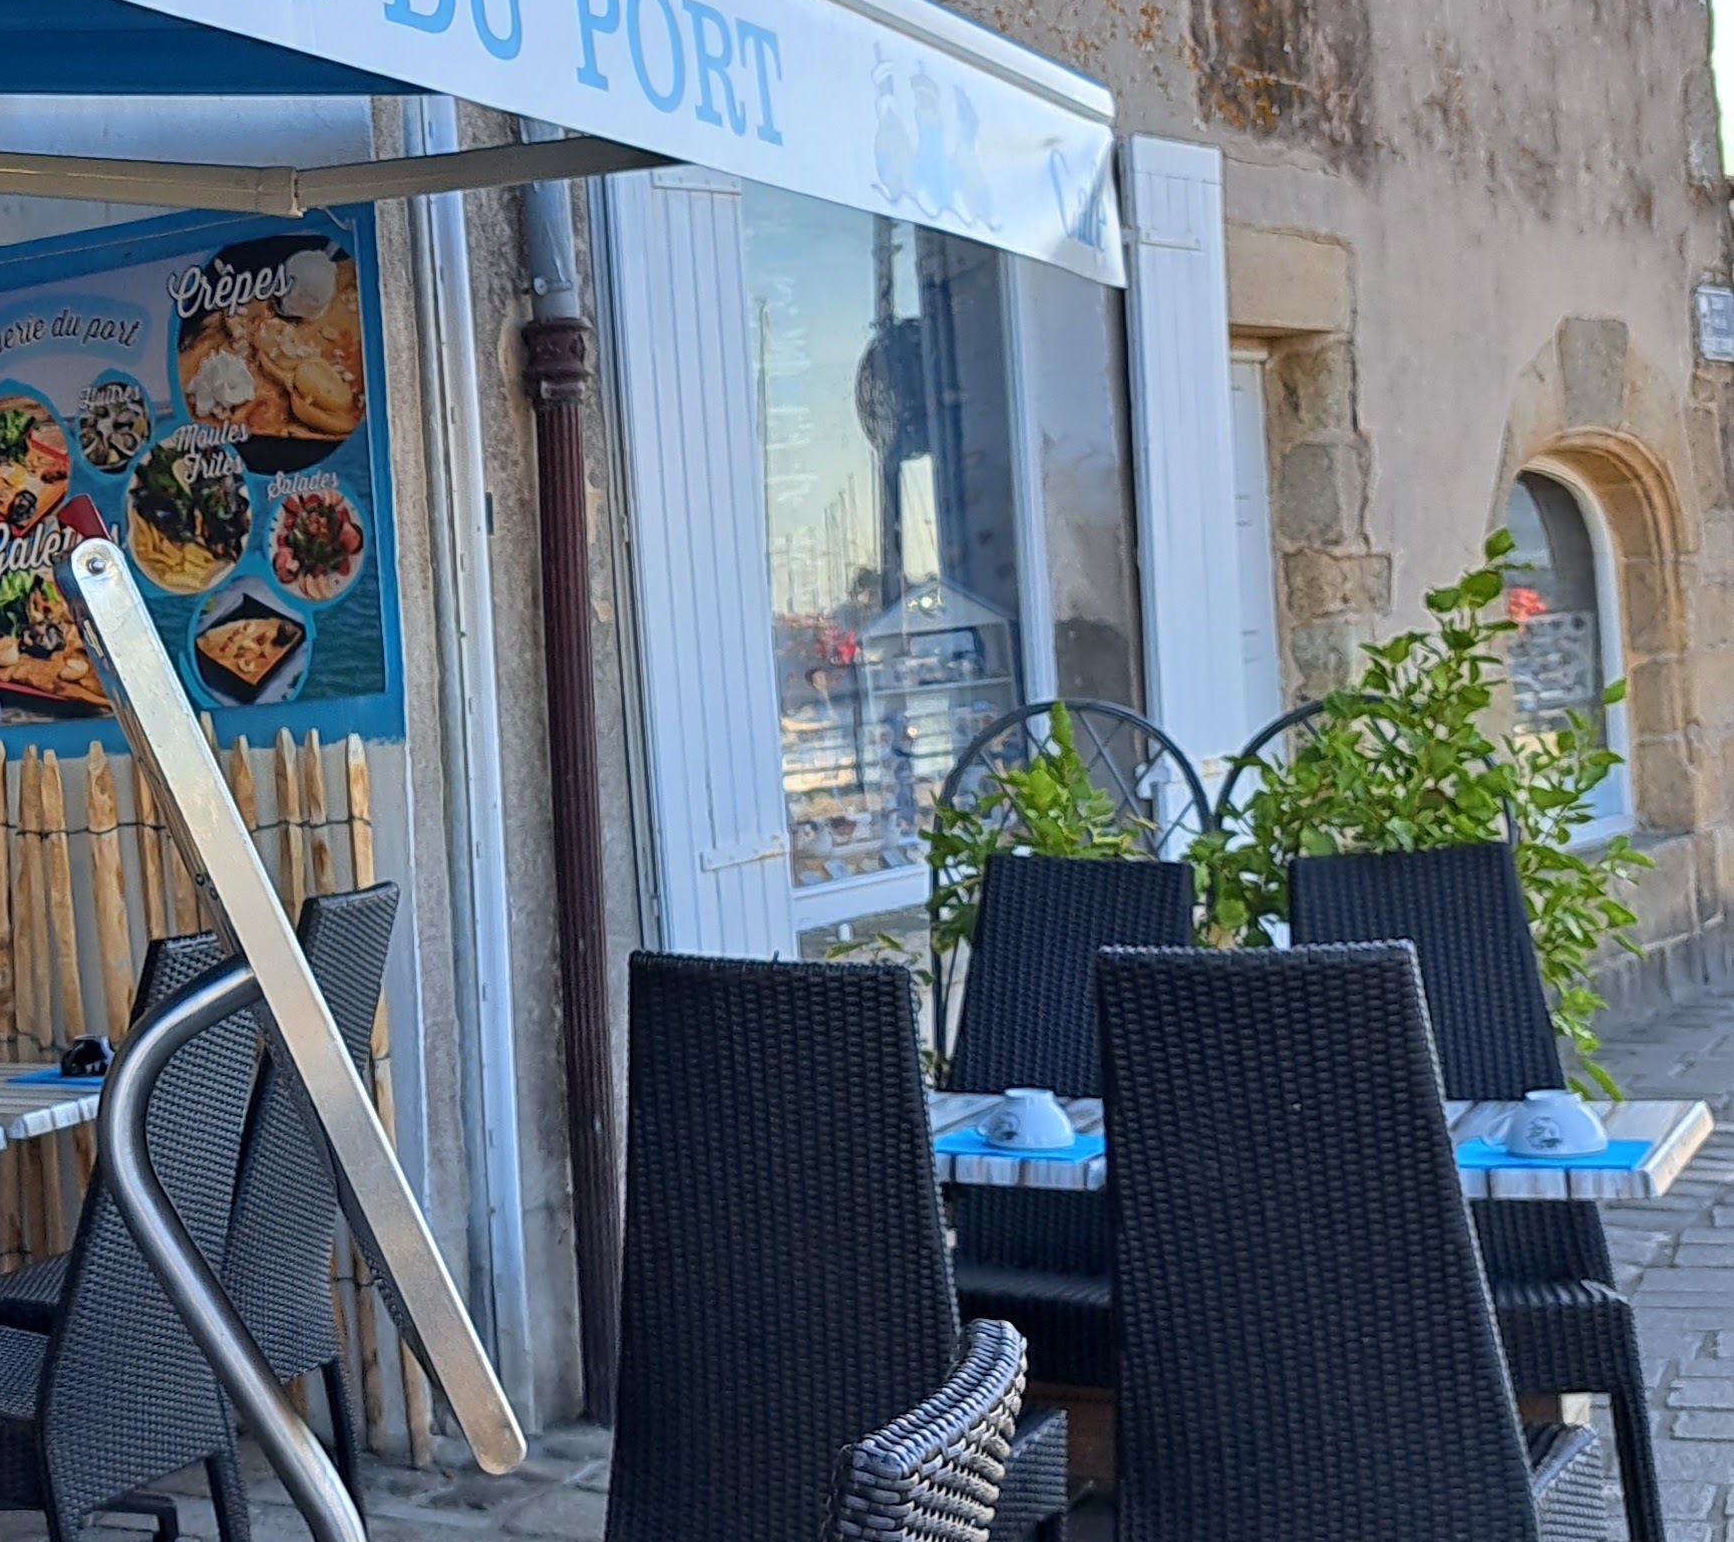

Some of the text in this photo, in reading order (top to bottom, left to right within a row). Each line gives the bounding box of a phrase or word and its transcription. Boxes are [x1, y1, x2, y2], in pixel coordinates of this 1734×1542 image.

[168, 263, 293, 319] Crêpes
[51, 307, 79, 339] du
[83, 317, 143, 348] port
[174, 422, 251, 454] Moules
[267, 470, 339, 501] Salades
